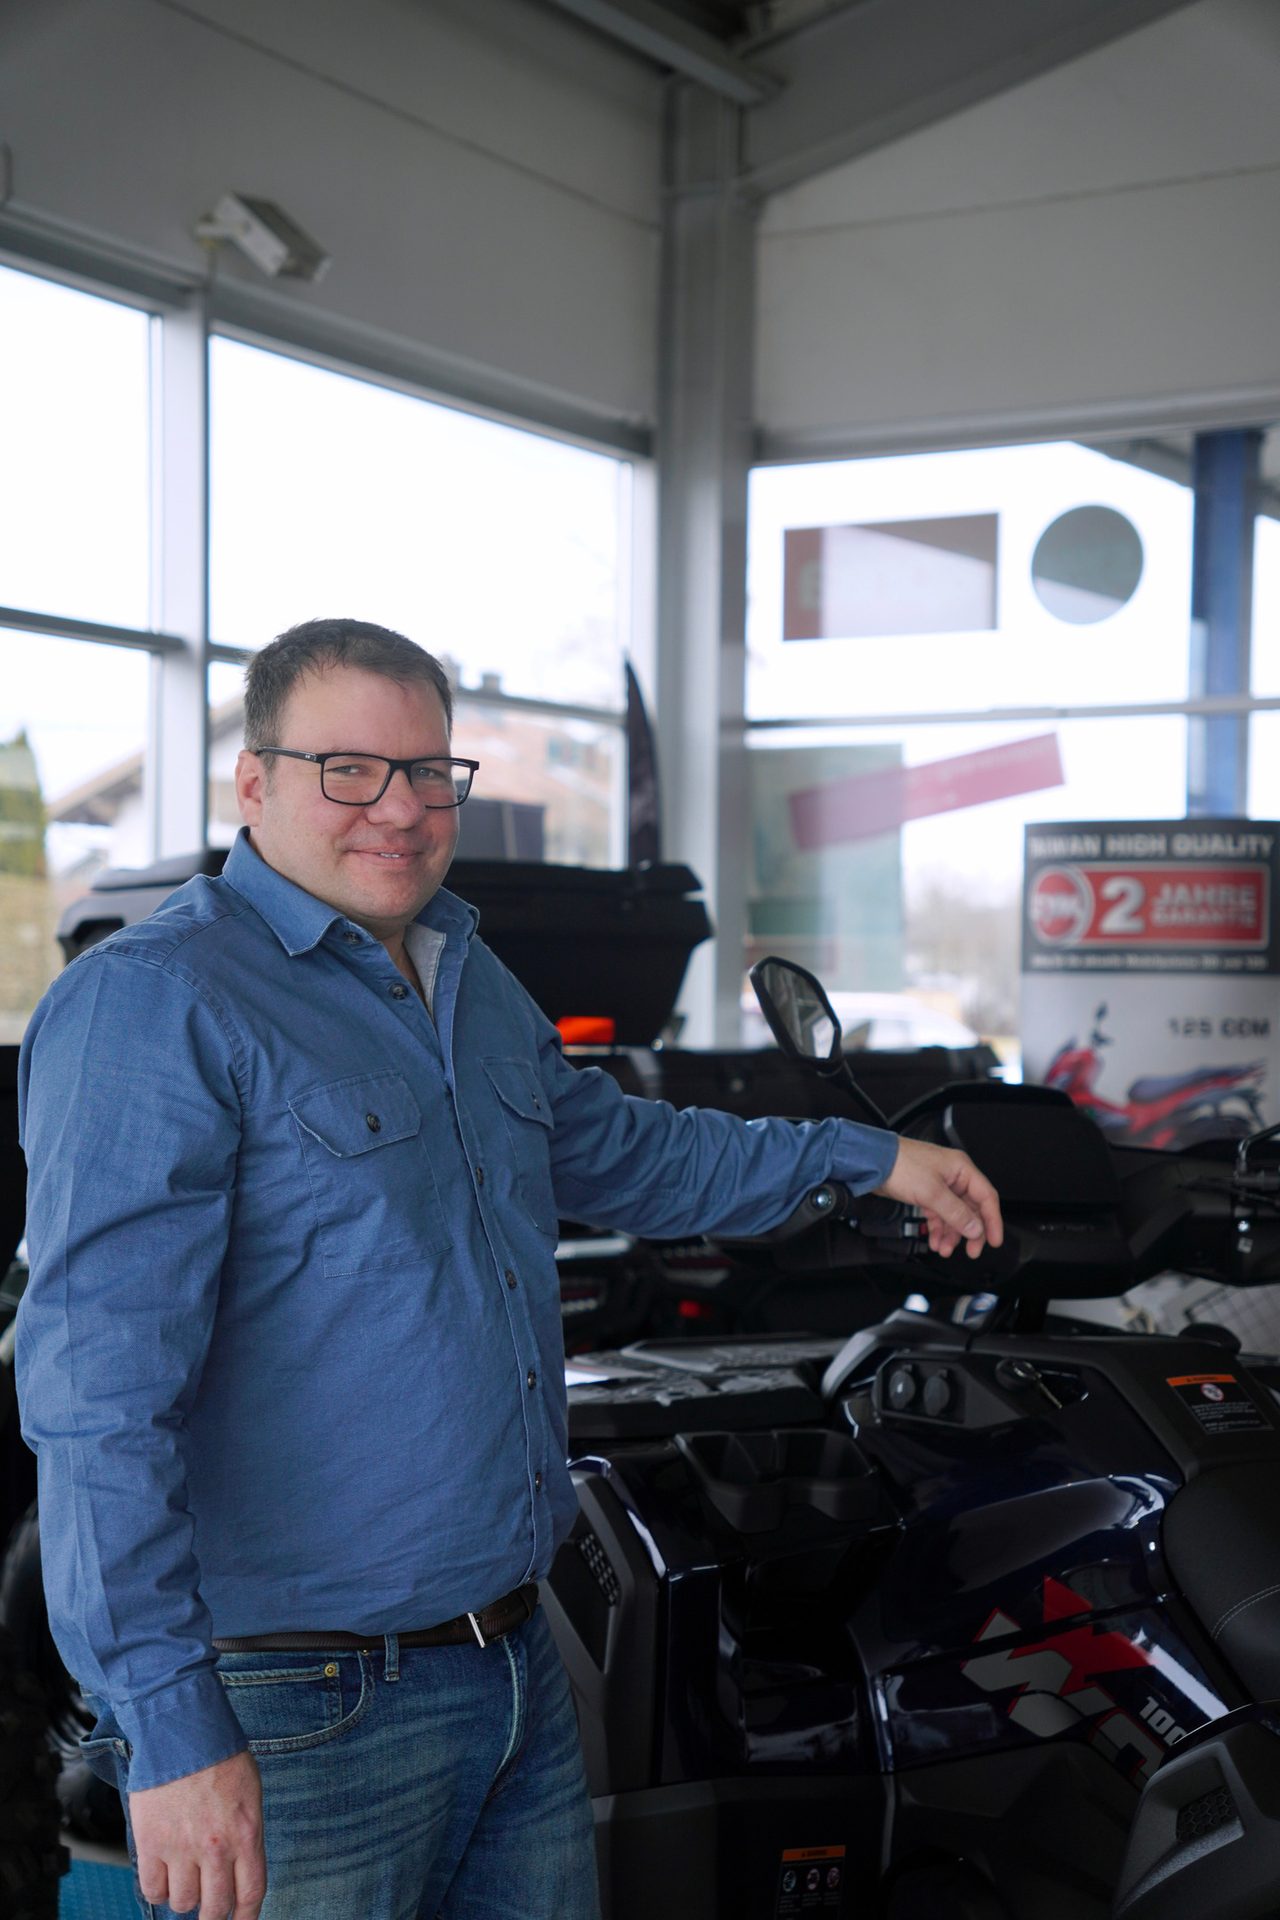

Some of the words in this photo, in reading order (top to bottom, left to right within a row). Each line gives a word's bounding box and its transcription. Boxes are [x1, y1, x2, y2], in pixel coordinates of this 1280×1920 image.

[1106, 834, 1167, 857] HIGH
[1172, 833, 1274, 857] QUALITY
[1101, 876, 1145, 934] 2
[1153, 883, 1257, 909] JAHRE
[1168, 1016, 1211, 1039] 125
[1220, 1016, 1271, 1039] CCM
